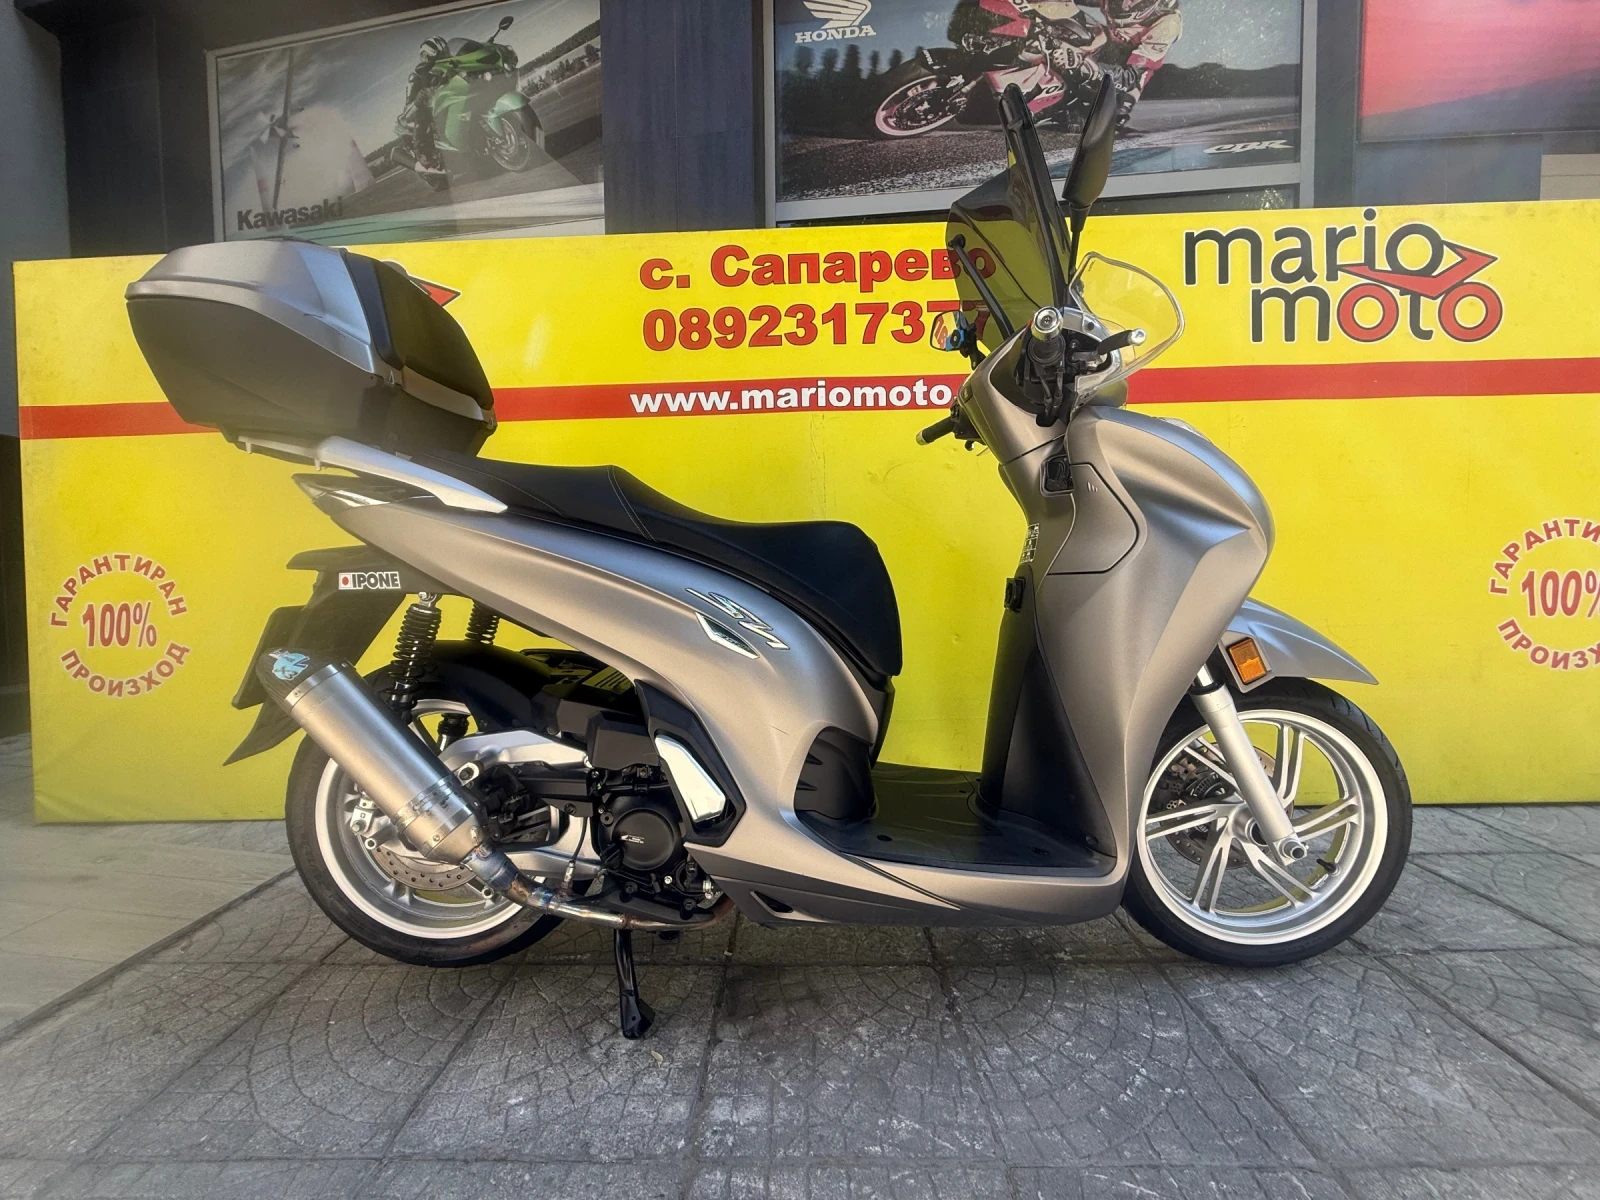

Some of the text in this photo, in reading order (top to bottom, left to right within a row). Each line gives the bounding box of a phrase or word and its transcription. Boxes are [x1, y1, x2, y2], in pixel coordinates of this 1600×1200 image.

[795, 25, 877, 44] HONDA
[237, 196, 343, 231] Kawasaki
[639, 244, 997, 293] с. Сапарево
[1184, 208, 1445, 286] mario
[1251, 282, 1503, 343] moto
[630, 380, 957, 414] www.mariomoto
[351, 572, 401, 589] IPONE
[1490, 519, 1600, 594] ГАРАНТИ
[51, 554, 187, 627] ГАРАНТИРАН
[82, 601, 157, 648] 100%
[61, 642, 190, 697] ПРОИЗХОД
